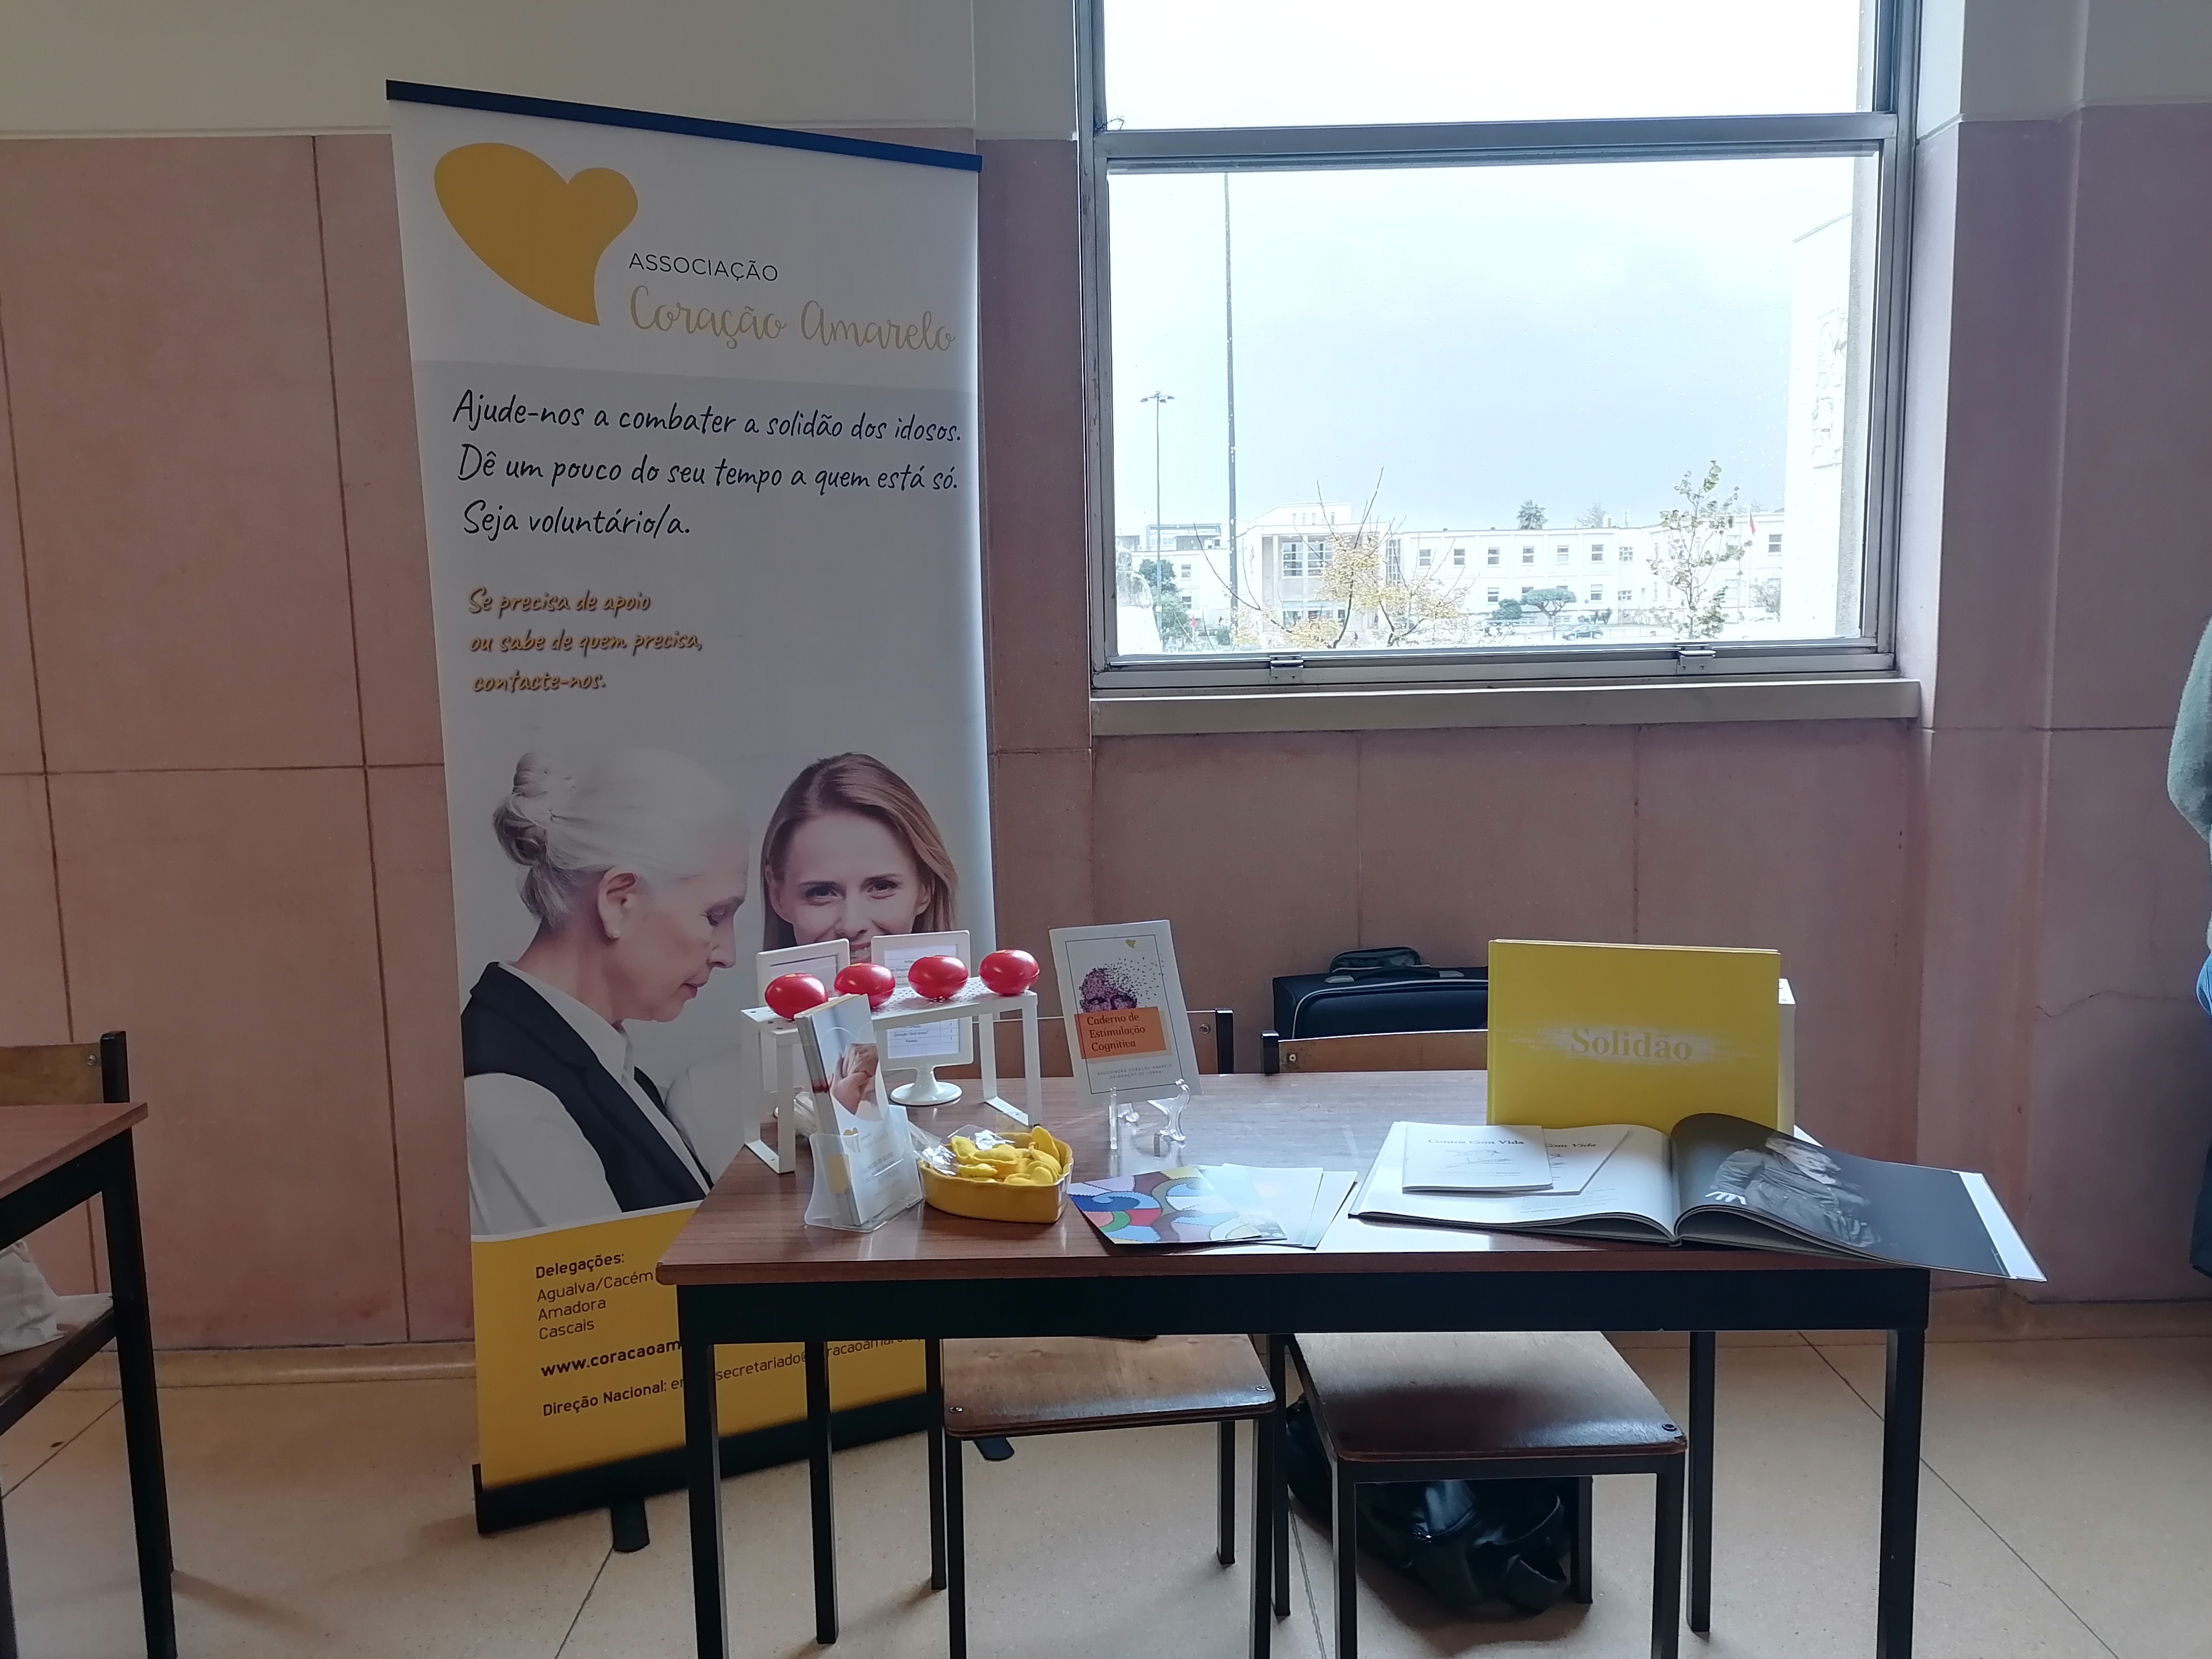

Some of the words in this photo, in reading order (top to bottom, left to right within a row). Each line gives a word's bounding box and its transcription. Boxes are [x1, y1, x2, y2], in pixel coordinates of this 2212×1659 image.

[629, 253, 778, 281] ASSOCIAÇÃO
[630, 285, 787, 349] Coração
[801, 300, 956, 351] Amarelo
[452, 389, 584, 431] Ajude-nos
[594, 410, 609, 426] a
[619, 403, 737, 434] combater
[744, 419, 759, 433] a
[766, 410, 842, 437] solidão
[852, 412, 886, 439] dos
[895, 414, 960, 441] idosos.
[458, 444, 496, 481] Dê
[507, 461, 544, 478] um
[551, 462, 621, 487] pouco
[632, 454, 659, 483] do
[667, 466, 705, 484] seu
[715, 458, 781, 493] tempo
[791, 470, 807, 485] a
[815, 471, 870, 495] quem
[878, 464, 925, 491] está
[933, 466, 957, 489] só.
[464, 499, 519, 541] Seja
[530, 504, 690, 539] voluntário/a.
[469, 587, 493, 614] Se
[498, 593, 571, 619] precisa
[576, 589, 597, 612] de
[603, 592, 651, 618] apoio
[471, 638, 493, 652] ou
[500, 629, 546, 653] sabe
[551, 629, 573, 651] de
[579, 637, 628, 658] quem
[633, 631, 702, 656] precisa,
[473, 670, 606, 693] contacte-nos.
[1087, 1015, 1126, 1025] Caderno
[1129, 1013, 1139, 1021] de
[1089, 1025, 1145, 1038] Estimulação
[1092, 1040, 1136, 1052] Cognitiva
[1571, 1028, 1693, 1060] Solidão
[536, 1254, 624, 1279] Delegações:
[537, 1272, 653, 1302] Agualva/Cacém
[538, 1300, 606, 1321] Amadora
[539, 1319, 594, 1339] Cascais
[543, 1396, 598, 1416] Direção
[603, 1380, 666, 1404] Nacional:
